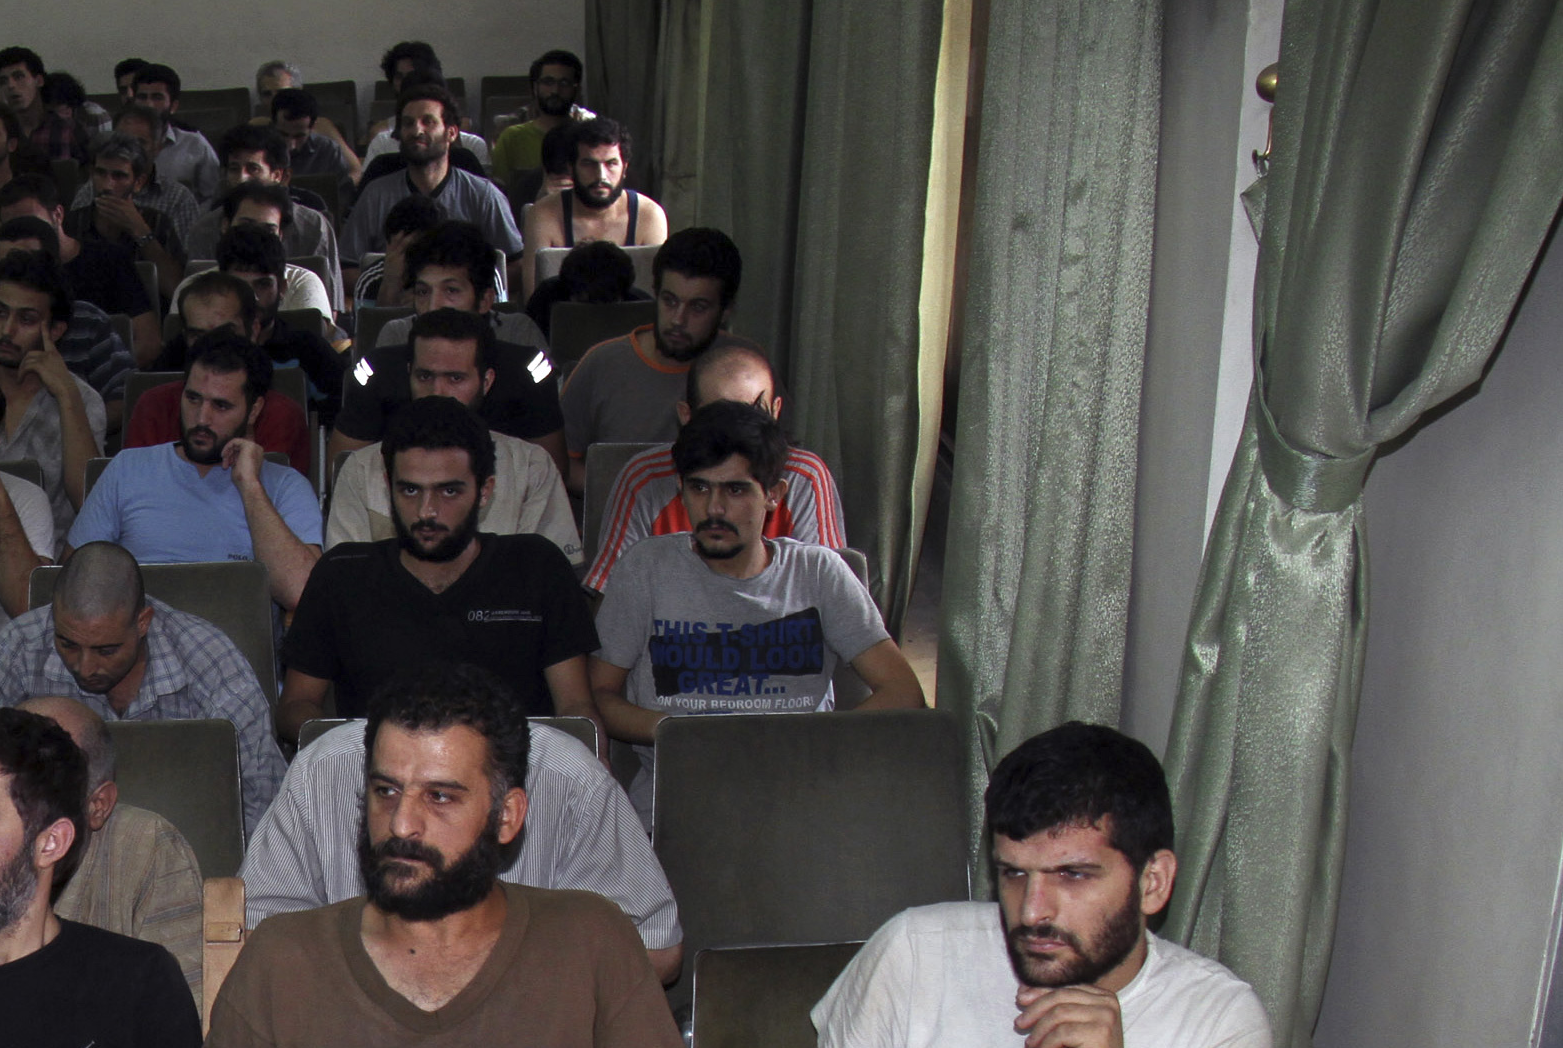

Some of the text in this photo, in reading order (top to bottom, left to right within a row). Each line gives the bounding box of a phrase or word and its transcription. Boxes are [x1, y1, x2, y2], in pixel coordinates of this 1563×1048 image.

[654, 618, 816, 647] THIS T-SHIRT
[677, 671, 786, 696] GREAT...
[676, 697, 708, 710] YOUR
[711, 698, 772, 710] BEDROOM
